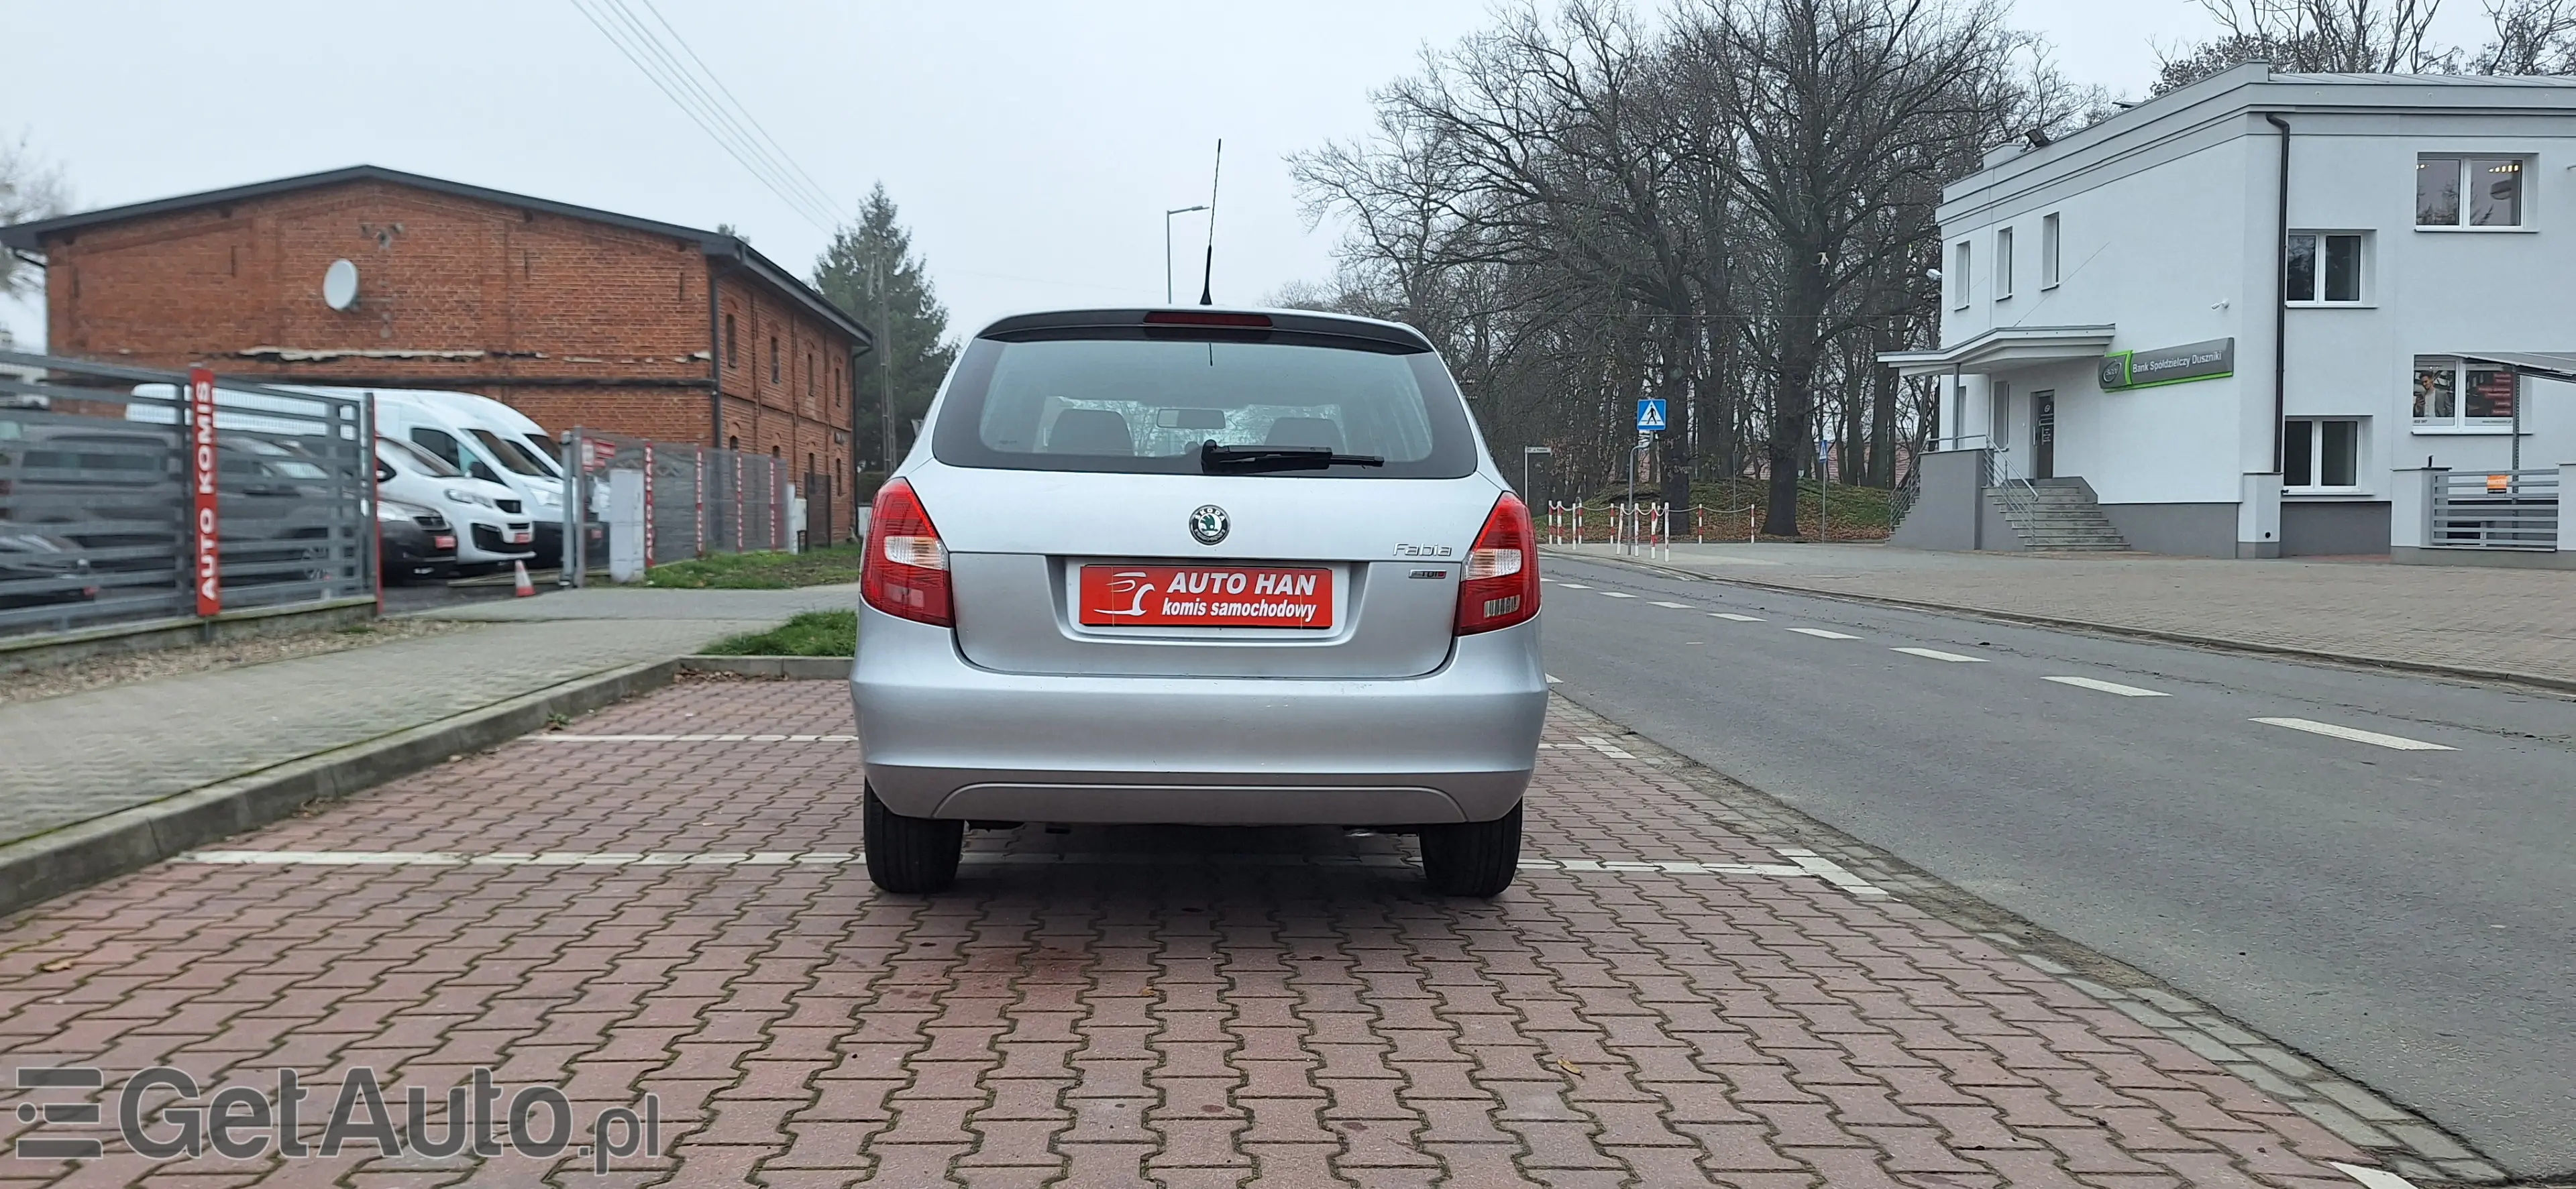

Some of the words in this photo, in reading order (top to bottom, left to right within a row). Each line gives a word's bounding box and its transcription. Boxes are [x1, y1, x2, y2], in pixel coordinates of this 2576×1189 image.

[2132, 361, 2149, 374] Bank
[2192, 351, 2222, 365] Duszniki
[197, 382, 213, 494] KOMIS
[200, 507, 217, 601] AUTO
[1393, 543, 1452, 557] Fabia
[1167, 572, 1247, 594] AUTO
[1254, 573, 1317, 596] HAN
[1162, 598, 1208, 616] komis
[1210, 600, 1317, 622] samochodowy
